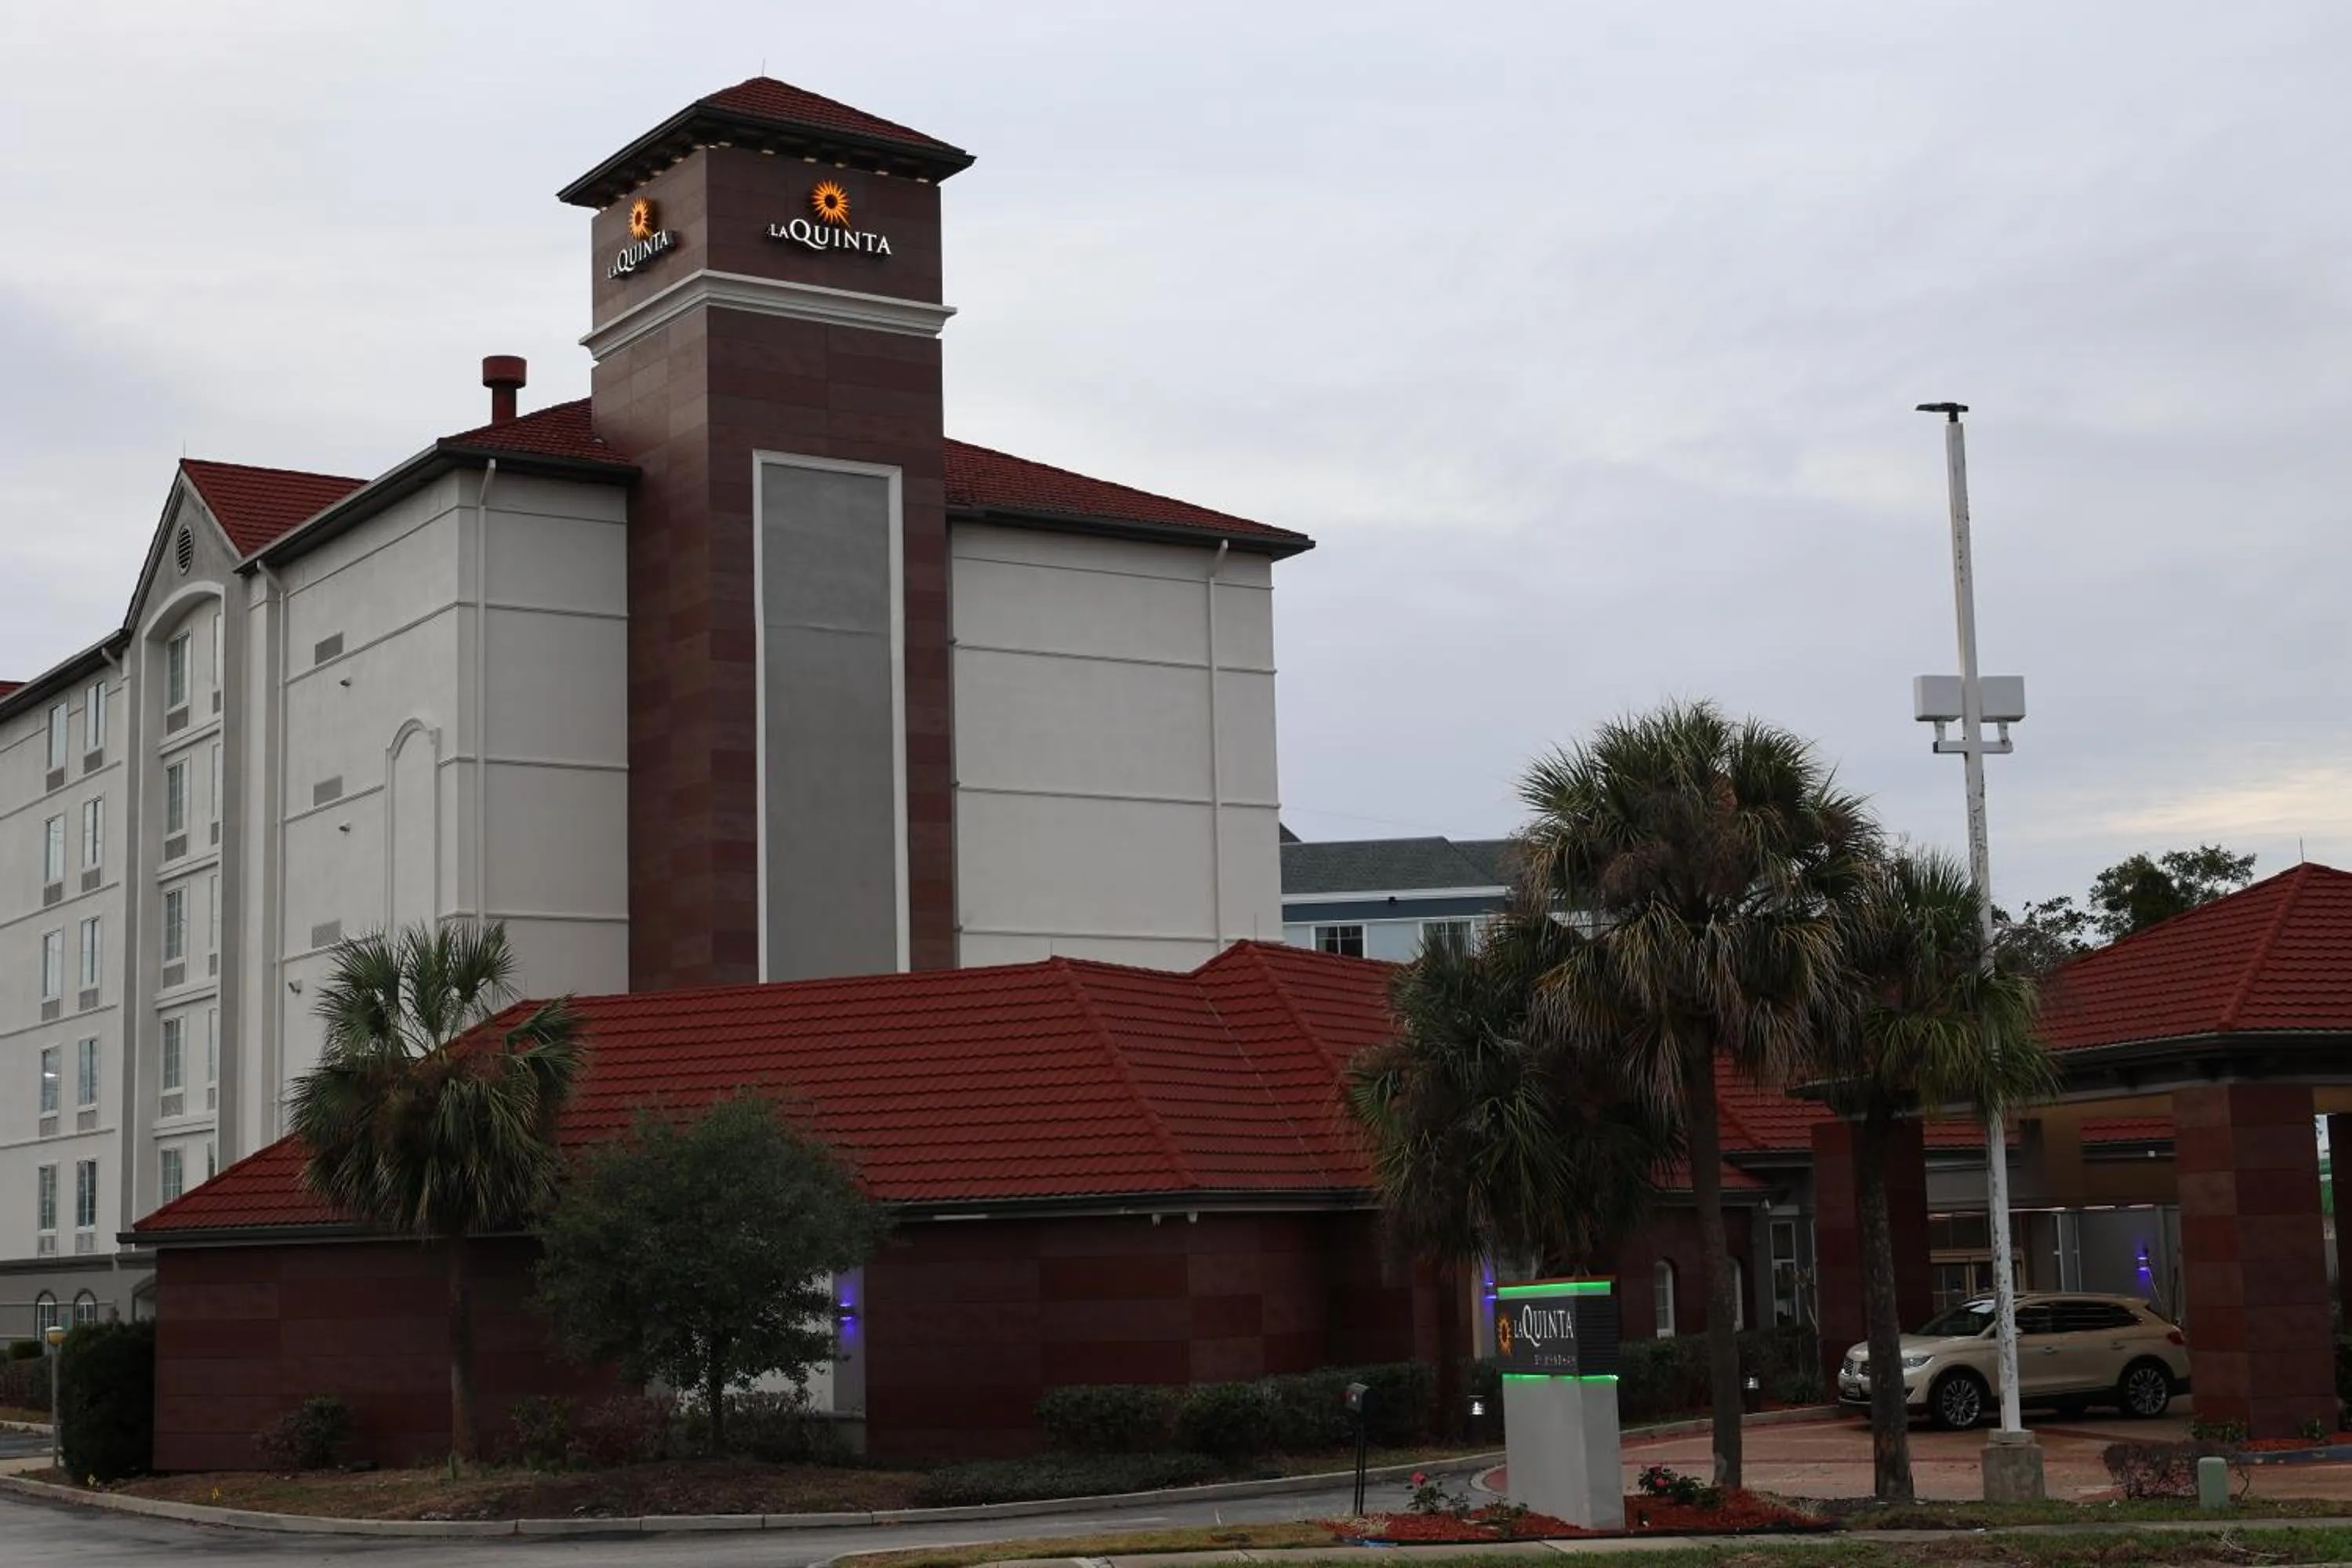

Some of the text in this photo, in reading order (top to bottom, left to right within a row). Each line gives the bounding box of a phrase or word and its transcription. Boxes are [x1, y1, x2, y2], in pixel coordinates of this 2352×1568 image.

[617, 228, 668, 272] QUINTA
[770, 219, 892, 255] LA QUINTA
[1522, 1304, 1573, 1348] QUINTA
